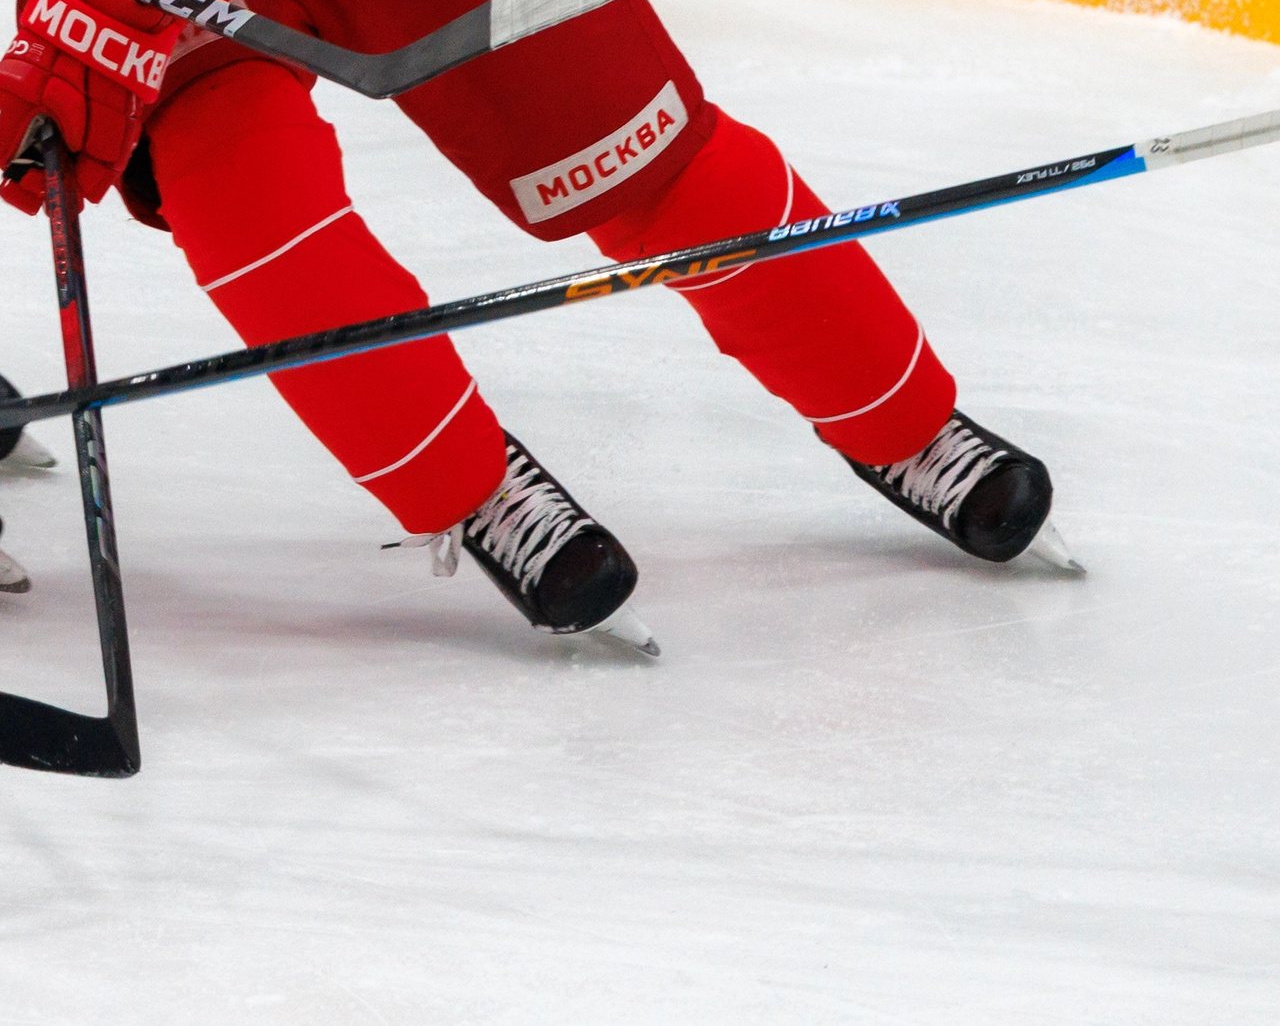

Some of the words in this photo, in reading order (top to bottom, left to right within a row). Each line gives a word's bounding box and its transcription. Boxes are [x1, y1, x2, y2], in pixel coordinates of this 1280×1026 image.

[535, 107, 675, 206] МОСКВА
[1016, 170, 1048, 185] FLEX
[768, 204, 877, 242] BAUER
